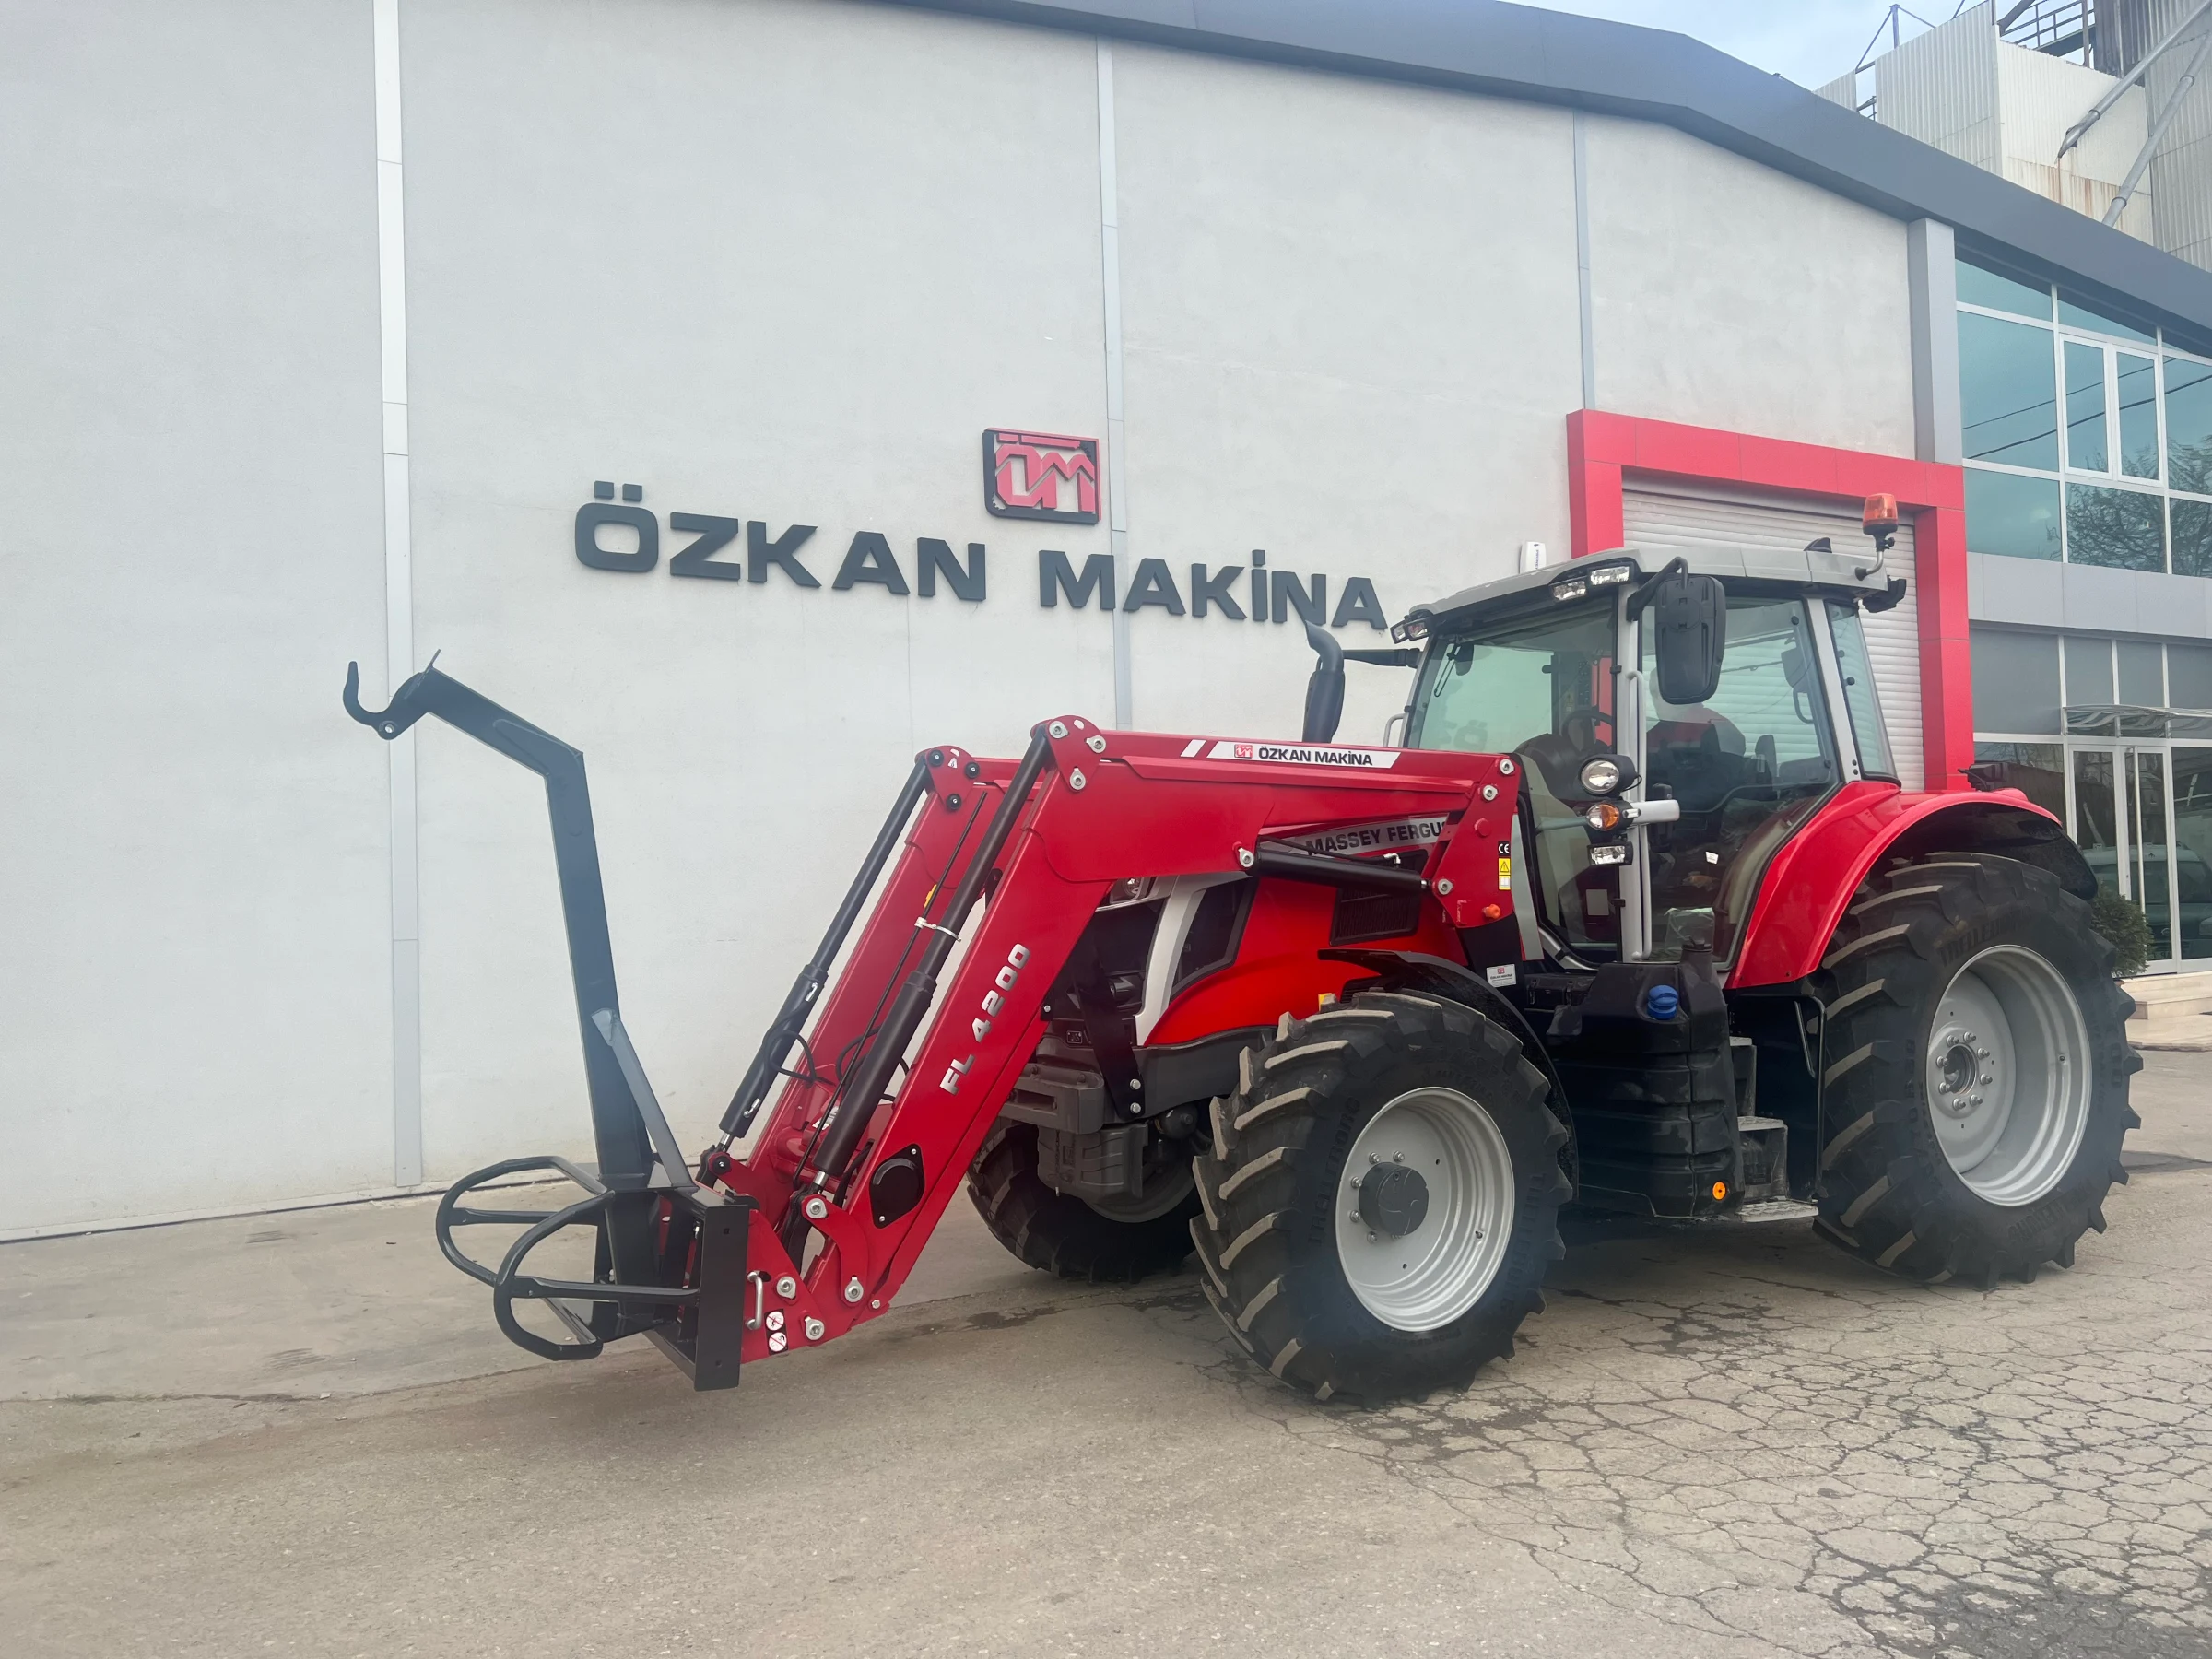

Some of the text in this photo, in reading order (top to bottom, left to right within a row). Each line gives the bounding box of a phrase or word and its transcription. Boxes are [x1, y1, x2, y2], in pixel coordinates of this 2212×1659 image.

[574, 480, 1389, 629] ÖZKAN MAKİNA
[1258, 746, 1373, 766] ÖZKAN MAKİNA
[1305, 828, 1382, 855] MASSEY
[939, 943, 1031, 1096] FL 4200
